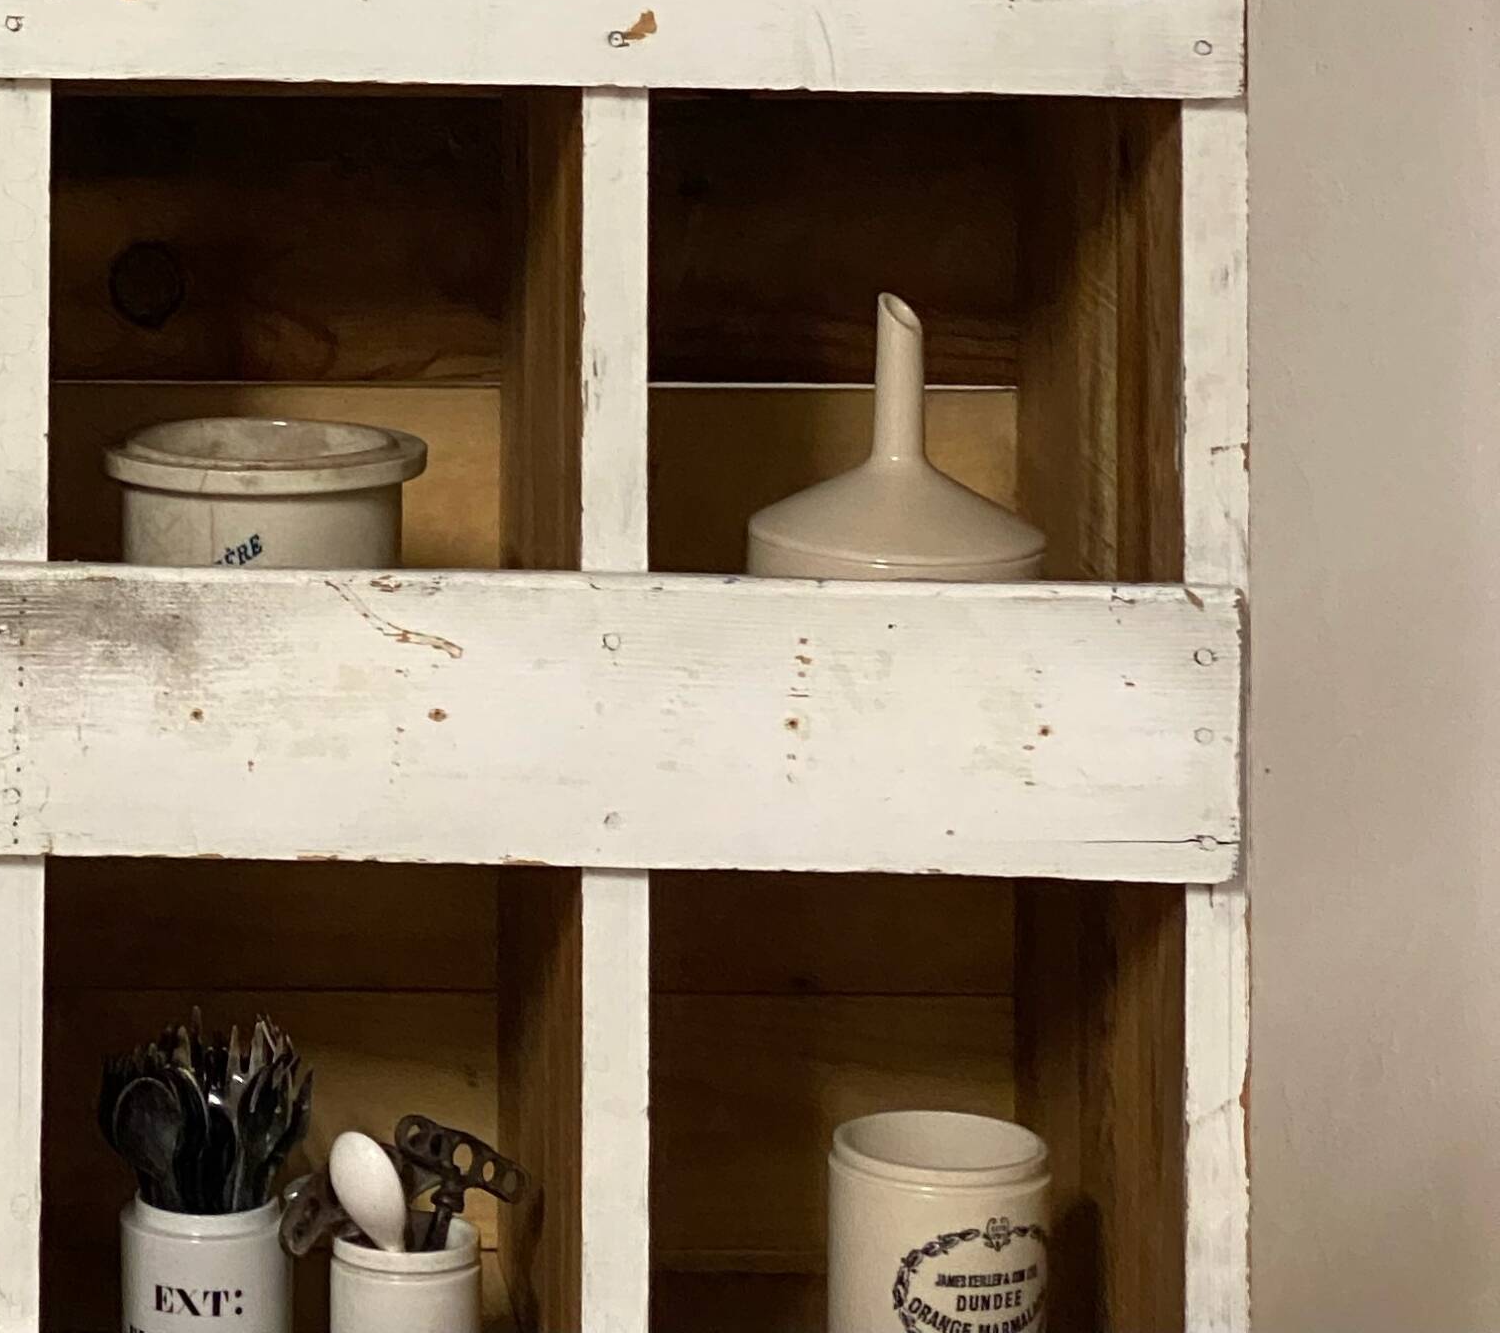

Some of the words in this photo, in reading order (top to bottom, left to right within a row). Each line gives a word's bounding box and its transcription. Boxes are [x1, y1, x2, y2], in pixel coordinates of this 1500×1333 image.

[155, 1284, 243, 1317] EXT:
[908, 1297, 972, 1333] ORANGE
[956, 1290, 1022, 1312] DUNDEE
